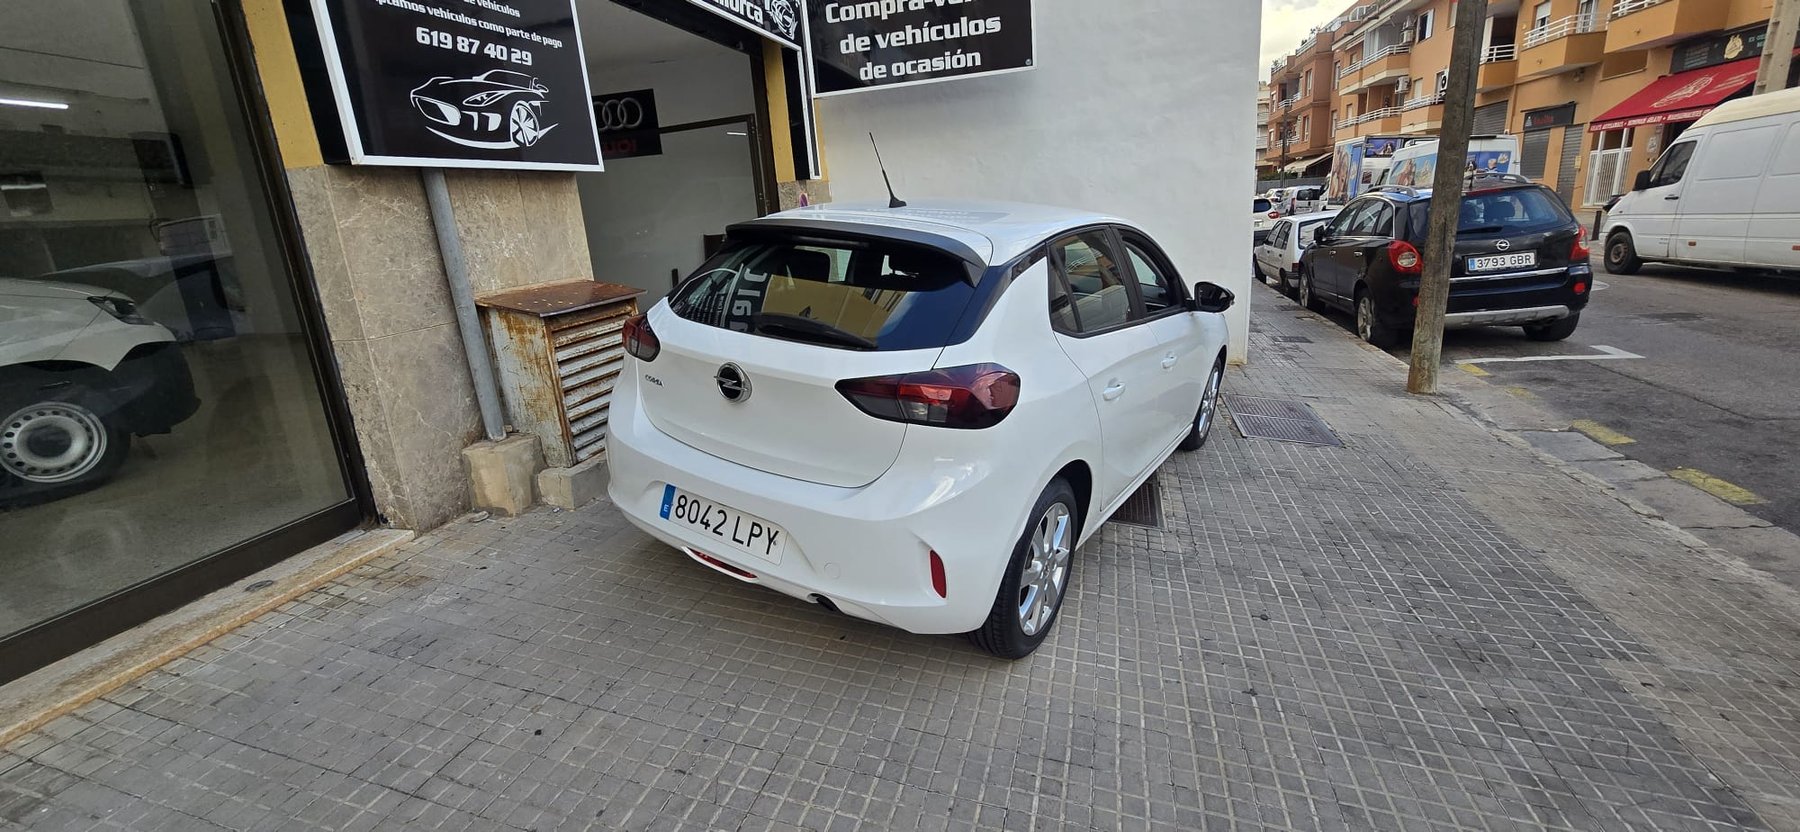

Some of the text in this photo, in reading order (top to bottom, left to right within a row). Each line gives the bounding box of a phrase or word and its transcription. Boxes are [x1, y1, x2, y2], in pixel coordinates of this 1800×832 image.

[376, 0, 427, 14] ptamos
[478, 19, 505, 34] como
[505, 27, 531, 40] parte
[531, 32, 542, 43] de
[542, 36, 563, 49] pago
[713, 0, 764, 25] orca
[825, 0, 971, 24] Compra-v
[416, 26, 533, 66] 619 87 40 29
[840, 16, 1002, 54] de vehículos
[859, 49, 982, 81] de ocasión
[1477, 255, 1531, 269] 3793 GBR
[675, 494, 728, 537] 8042
[731, 515, 780, 555] LPY
